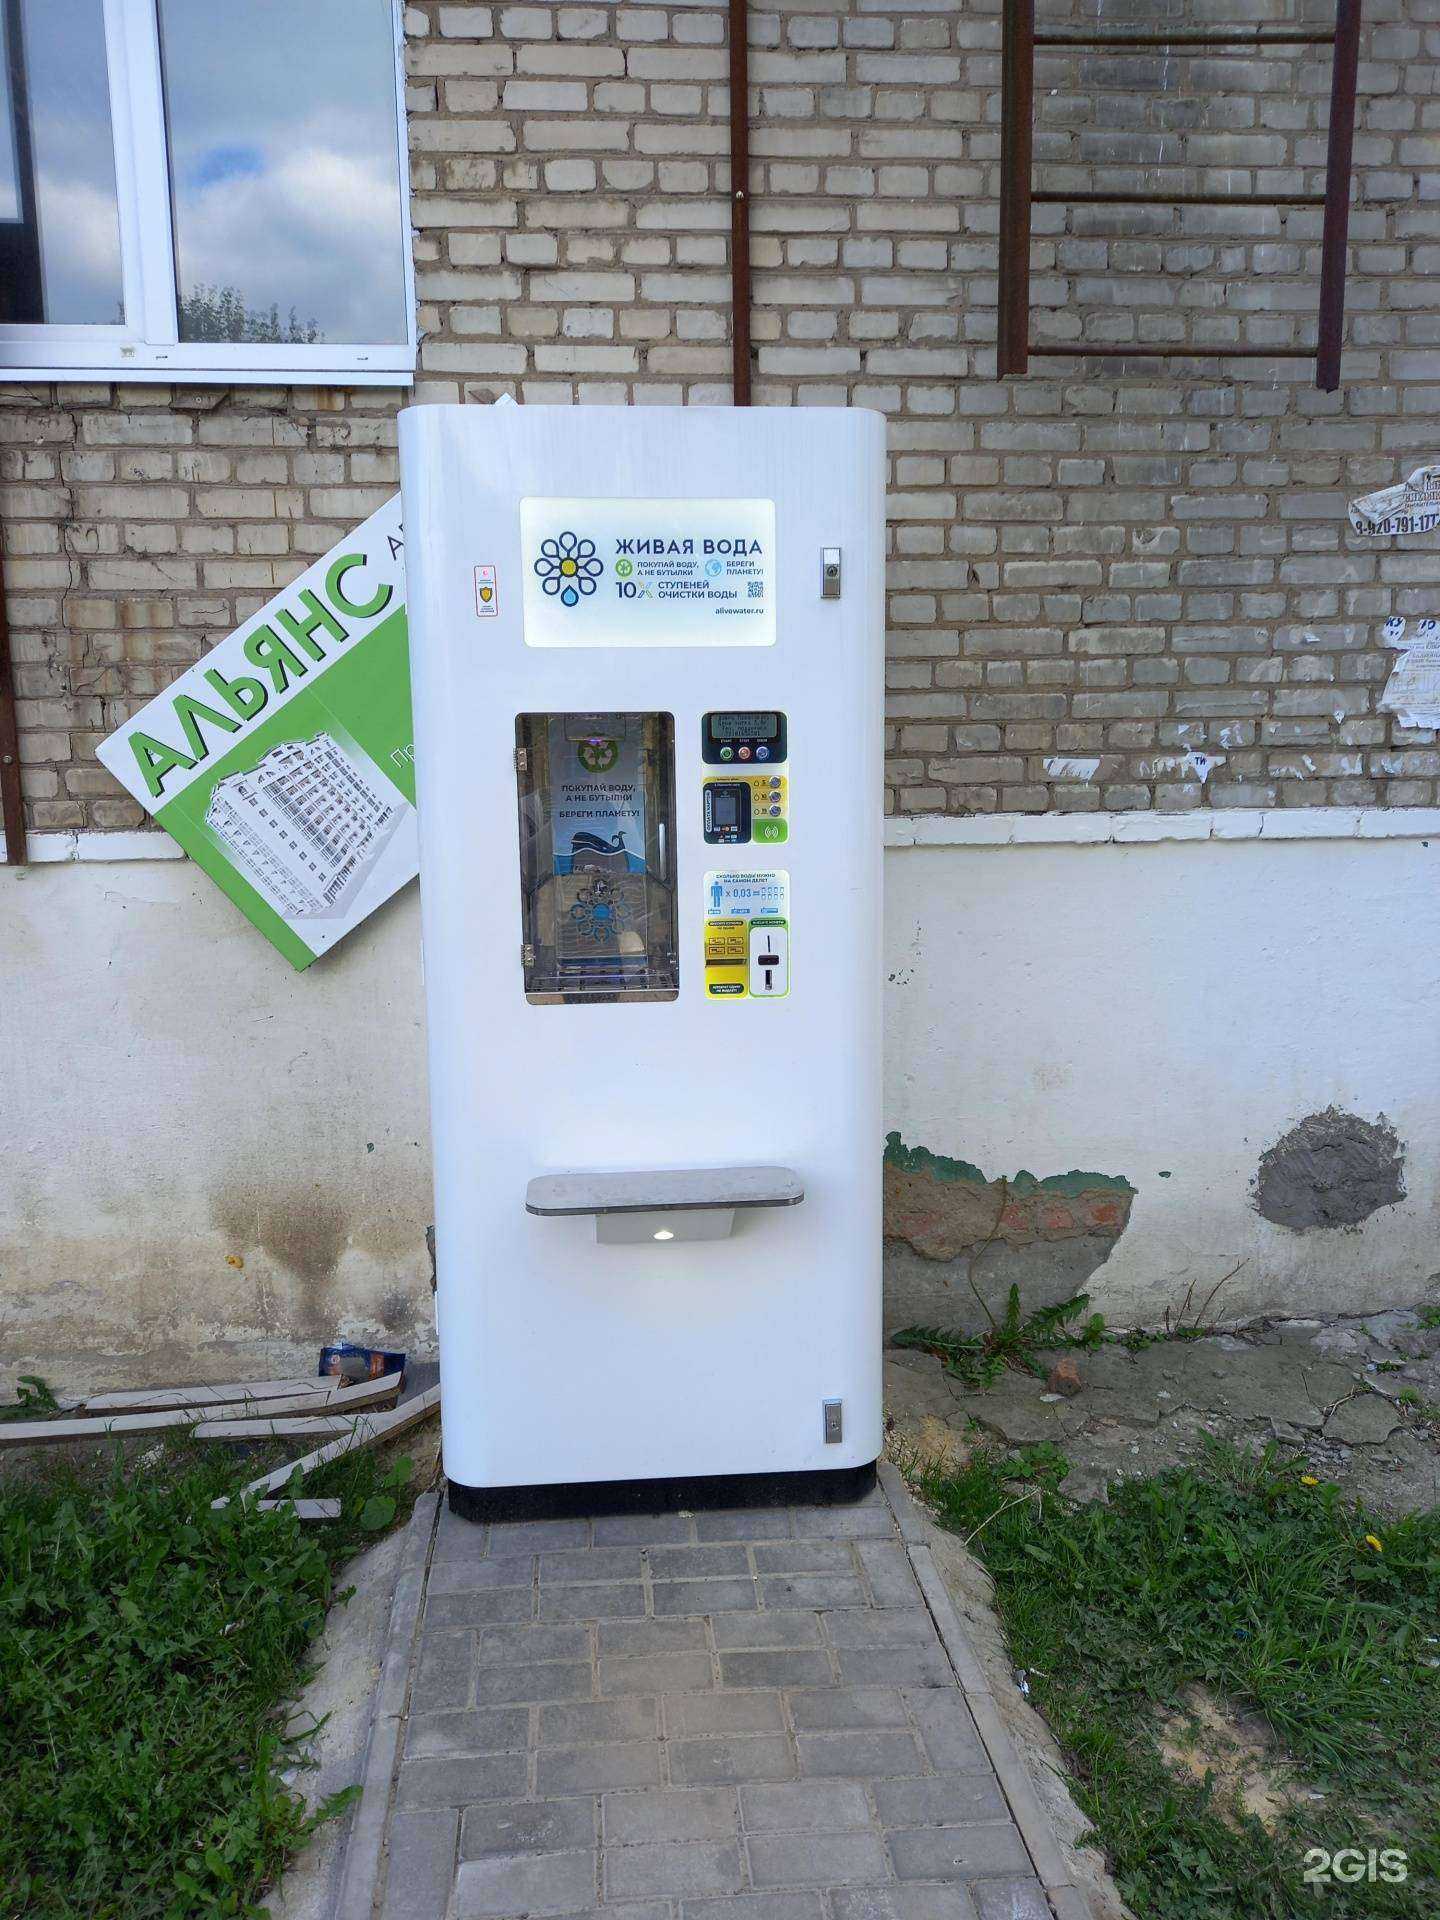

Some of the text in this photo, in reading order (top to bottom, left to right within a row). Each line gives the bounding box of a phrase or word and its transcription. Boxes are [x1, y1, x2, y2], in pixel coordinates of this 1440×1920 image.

[616, 539, 763, 557] ЖИВАЯ ВОДА
[637, 560, 699, 570] ПОКУПАЙ ВОДУ,
[726, 560, 755, 568] БЕРЕГИ
[656, 568, 693, 576] БУТЫЛКИ
[726, 568, 764, 576] ПЛАНЕТУ!
[658, 579, 710, 589] СТУПЕНЕЙ
[658, 590, 738, 600] ОЧИСТКИ ВОДЫ
[127, 553, 393, 798] АЛЬЯНС
[561, 783, 636, 792] ПОКУПАЙ ВОДУ,
[565, 794, 572, 802] А
[588, 794, 633, 802] БУТЫЛКИ
[559, 810, 593, 818] БЕРЕГИ
[733, 888, 752, 899] 0,03
